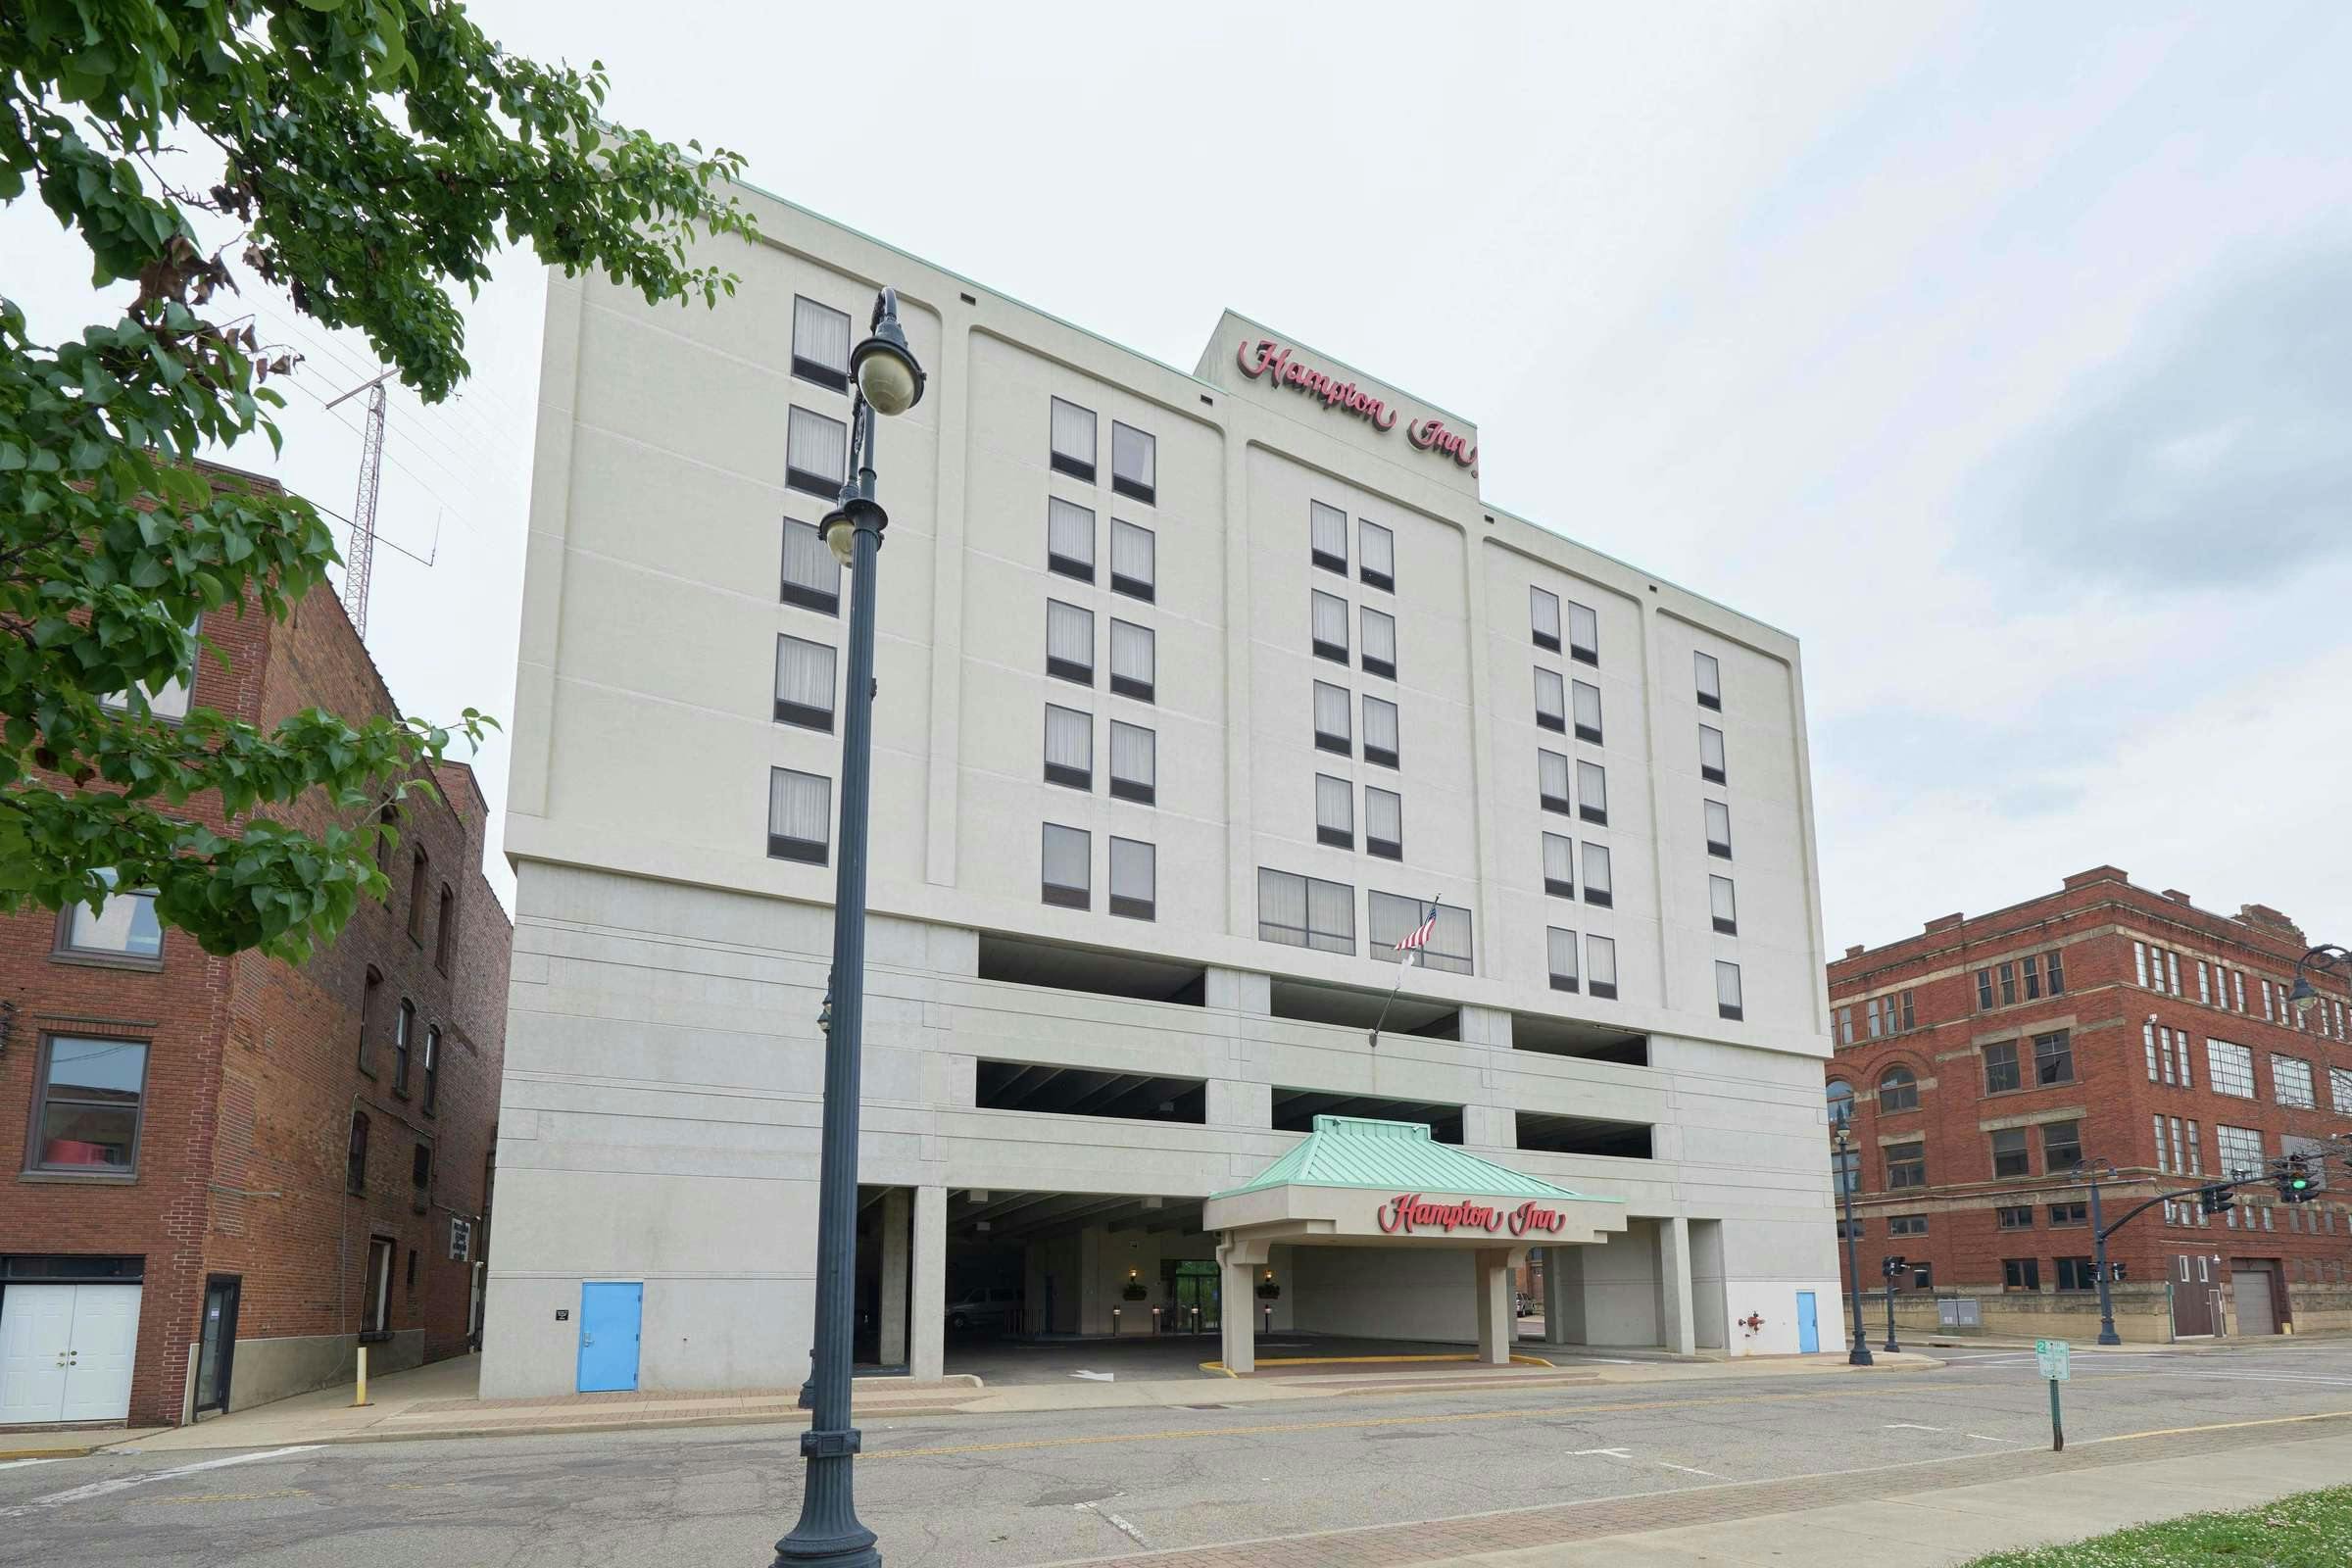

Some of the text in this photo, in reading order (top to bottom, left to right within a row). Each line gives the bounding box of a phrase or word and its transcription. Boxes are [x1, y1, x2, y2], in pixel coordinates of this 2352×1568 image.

[1238, 340, 1478, 466] Hampton Inn
[1378, 1194, 1566, 1236] Hampton Inn
[2037, 1342, 2046, 1352] 2
